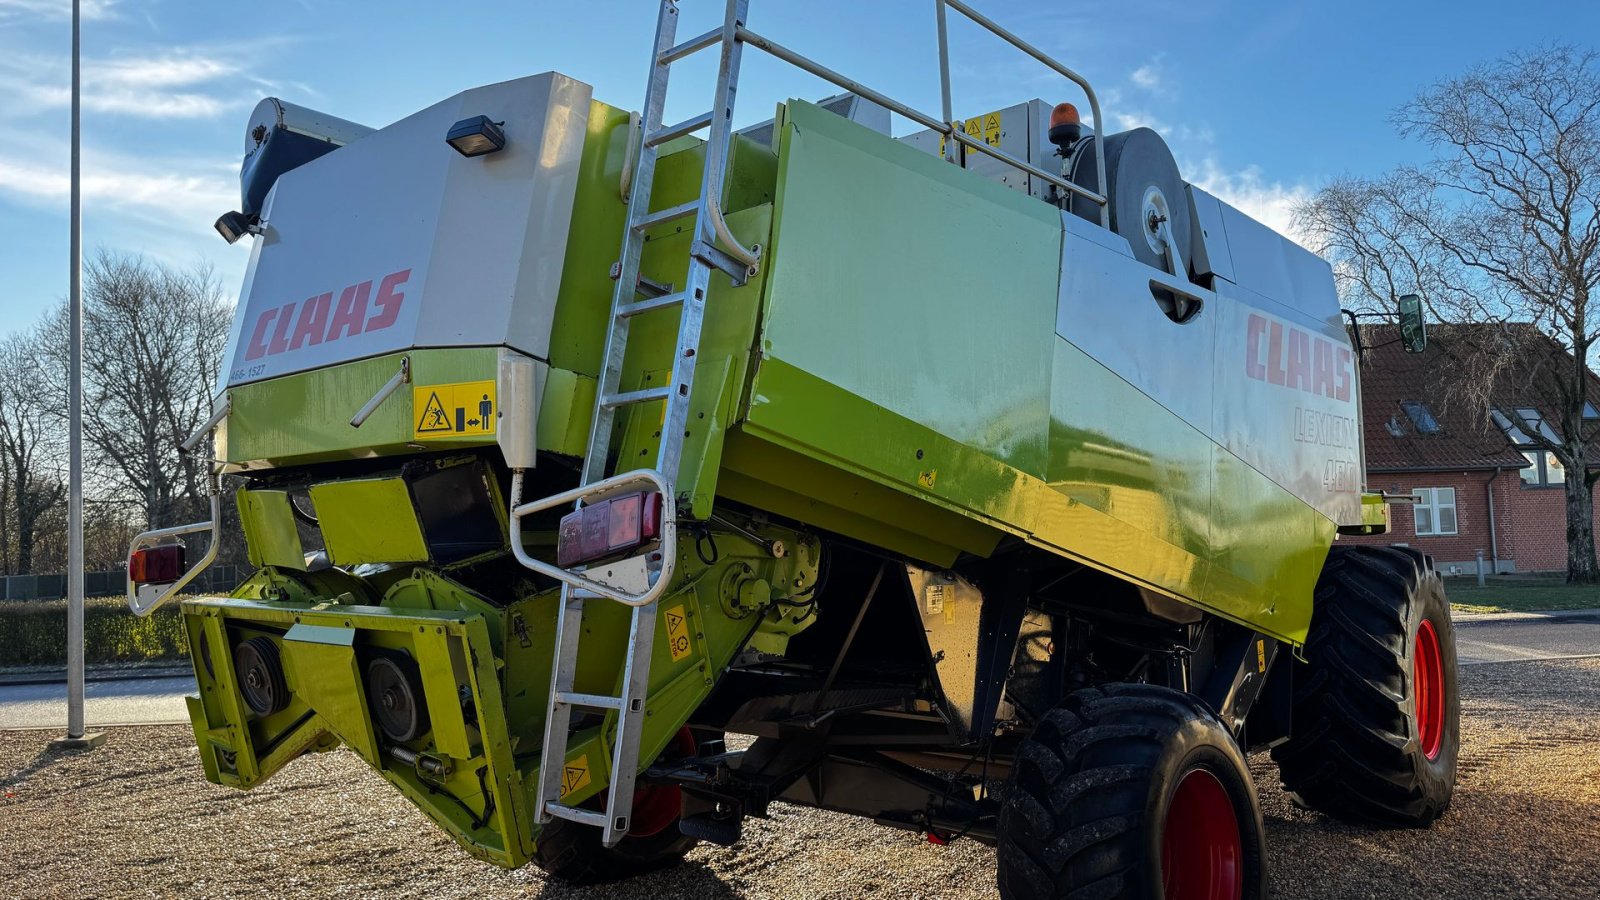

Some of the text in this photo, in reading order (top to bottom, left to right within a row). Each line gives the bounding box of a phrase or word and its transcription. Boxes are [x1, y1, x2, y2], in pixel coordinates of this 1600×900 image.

[244, 268, 412, 362] CLAAS
[1245, 313, 1351, 403] CLAAS
[1293, 406, 1355, 450] LEXION
[1323, 459, 1357, 493] 480
